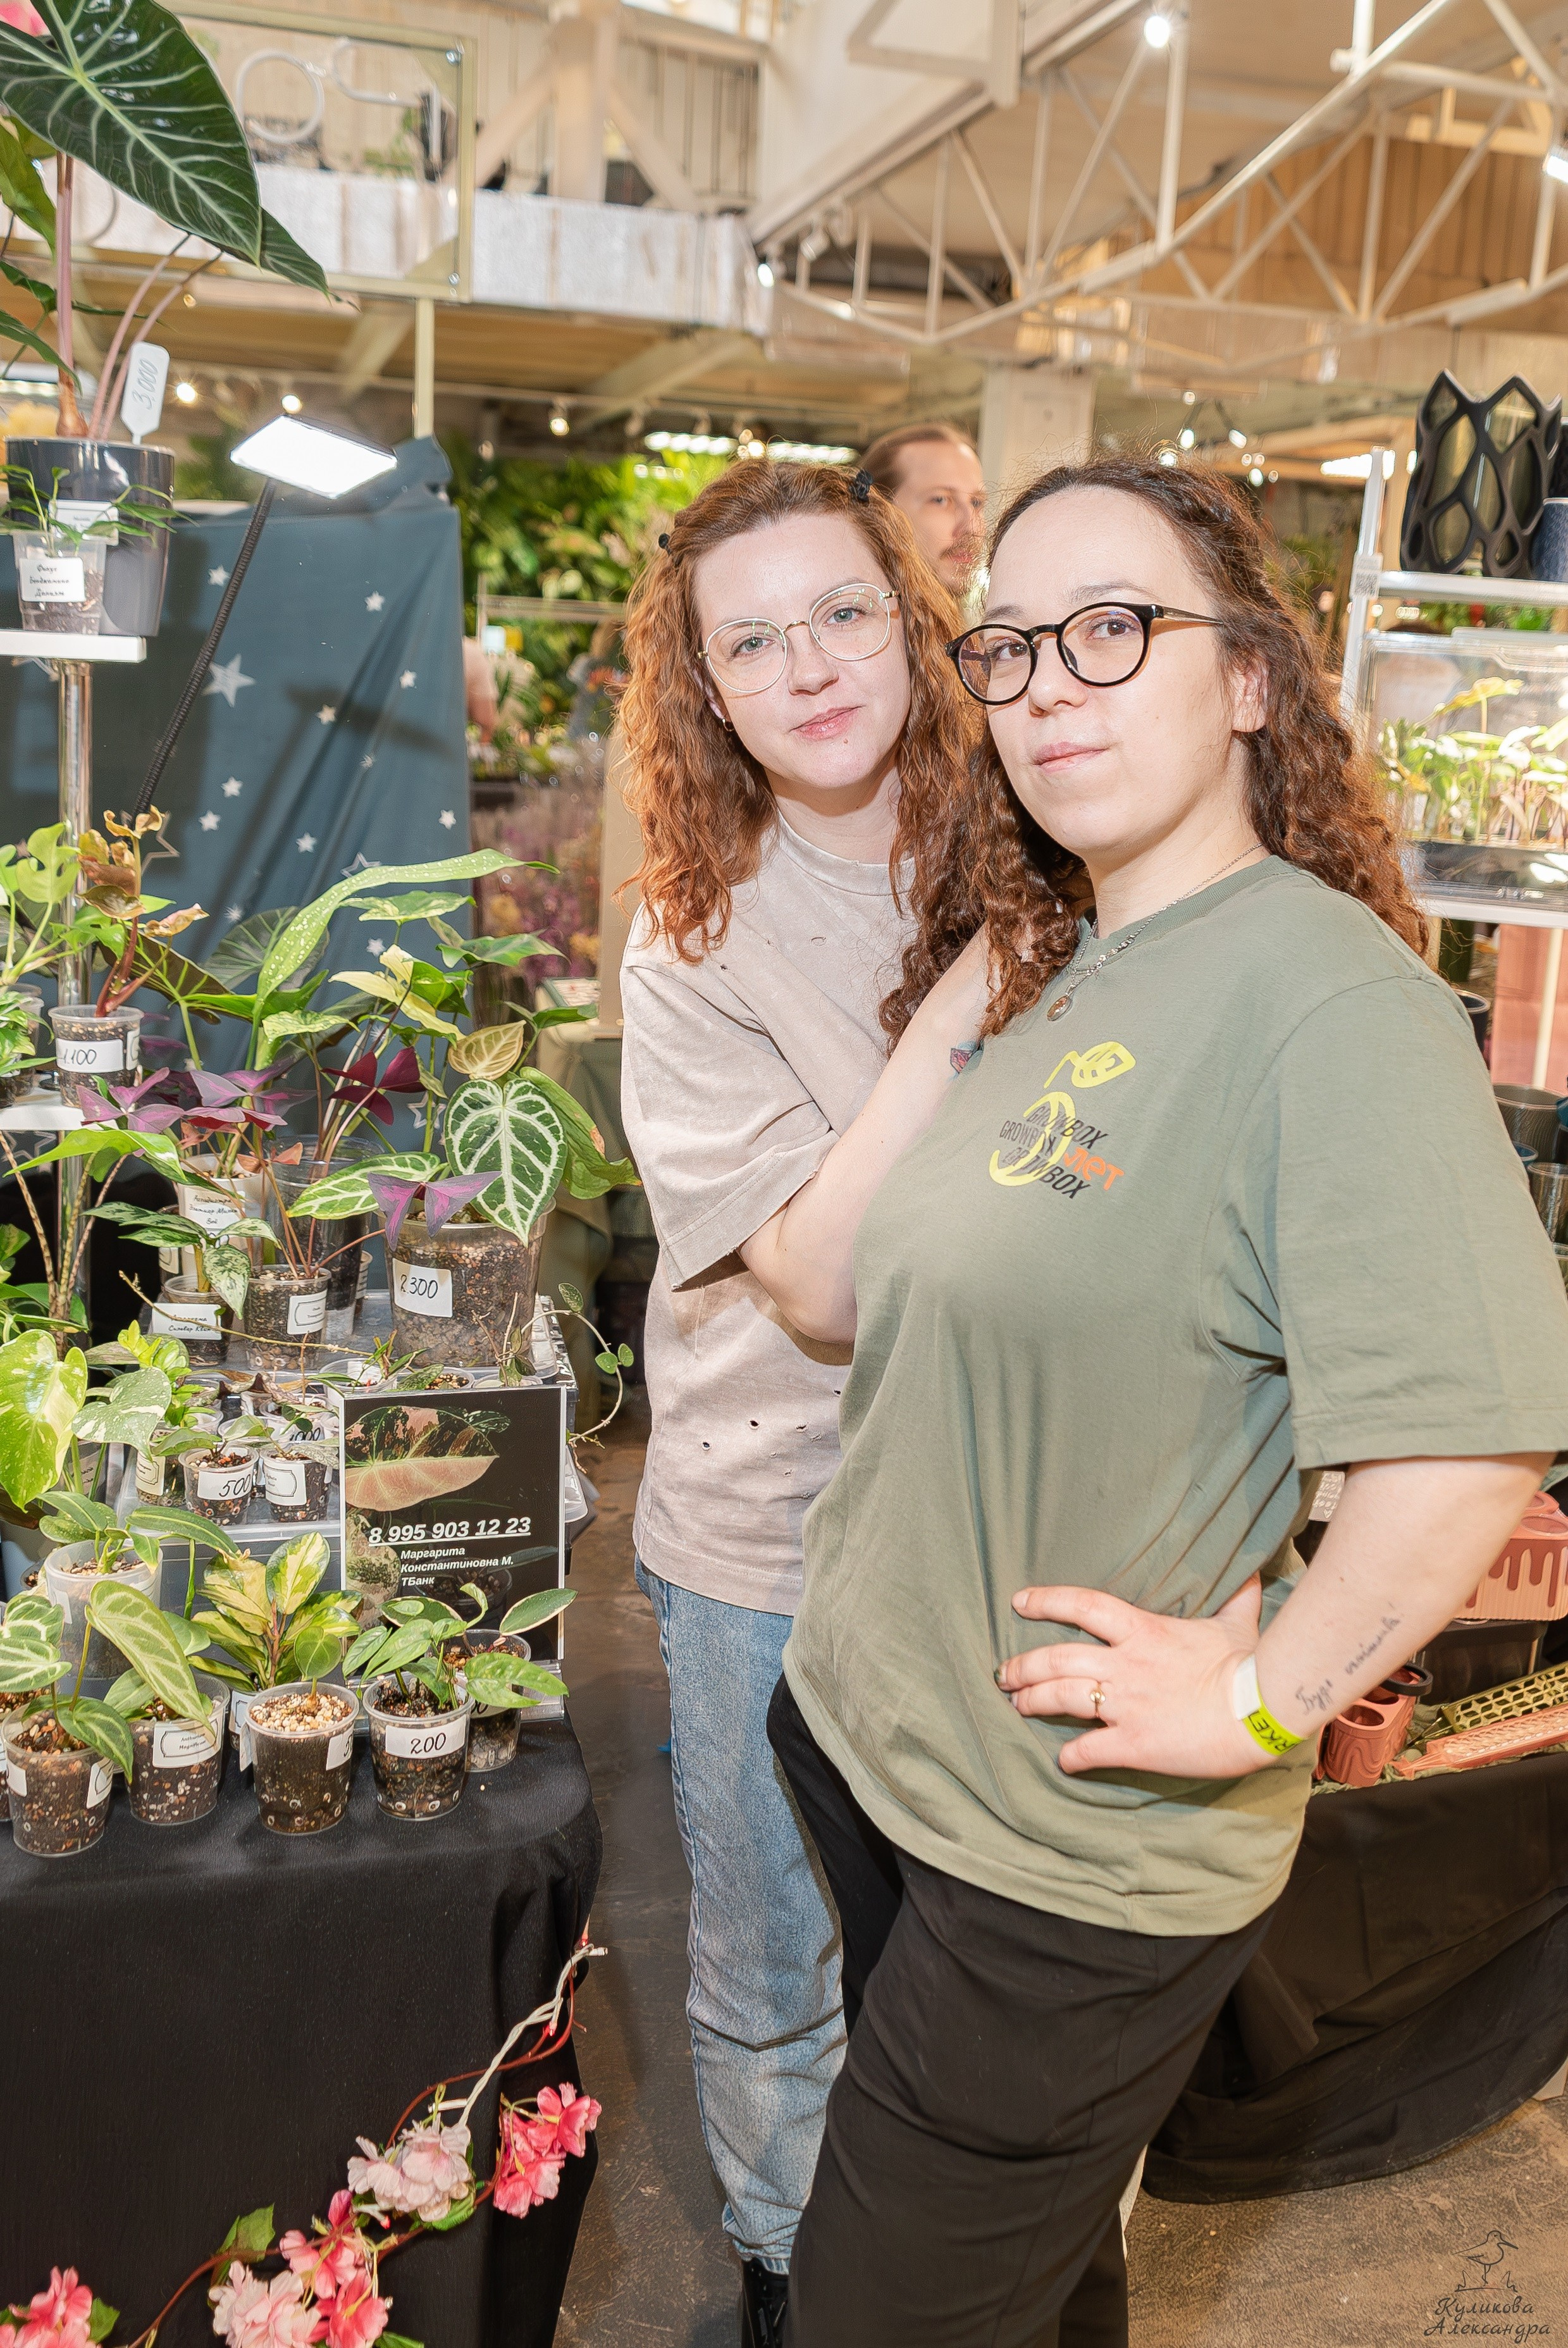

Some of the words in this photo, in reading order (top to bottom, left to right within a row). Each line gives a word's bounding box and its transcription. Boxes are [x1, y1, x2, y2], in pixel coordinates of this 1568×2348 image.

[219, 1474, 251, 1497] 500
[368, 1527, 383, 1544] 8
[388, 1524, 426, 1543] 995
[431, 1521, 470, 1539] 903
[475, 1519, 500, 1536] 12
[505, 1517, 531, 1534] 23
[400, 1547, 466, 1560] Маргарита
[400, 1558, 499, 1574] Константиновна
[501, 1556, 514, 1566] М.
[401, 1575, 436, 1587] ТБанк
[411, 1732, 447, 1755] 200
